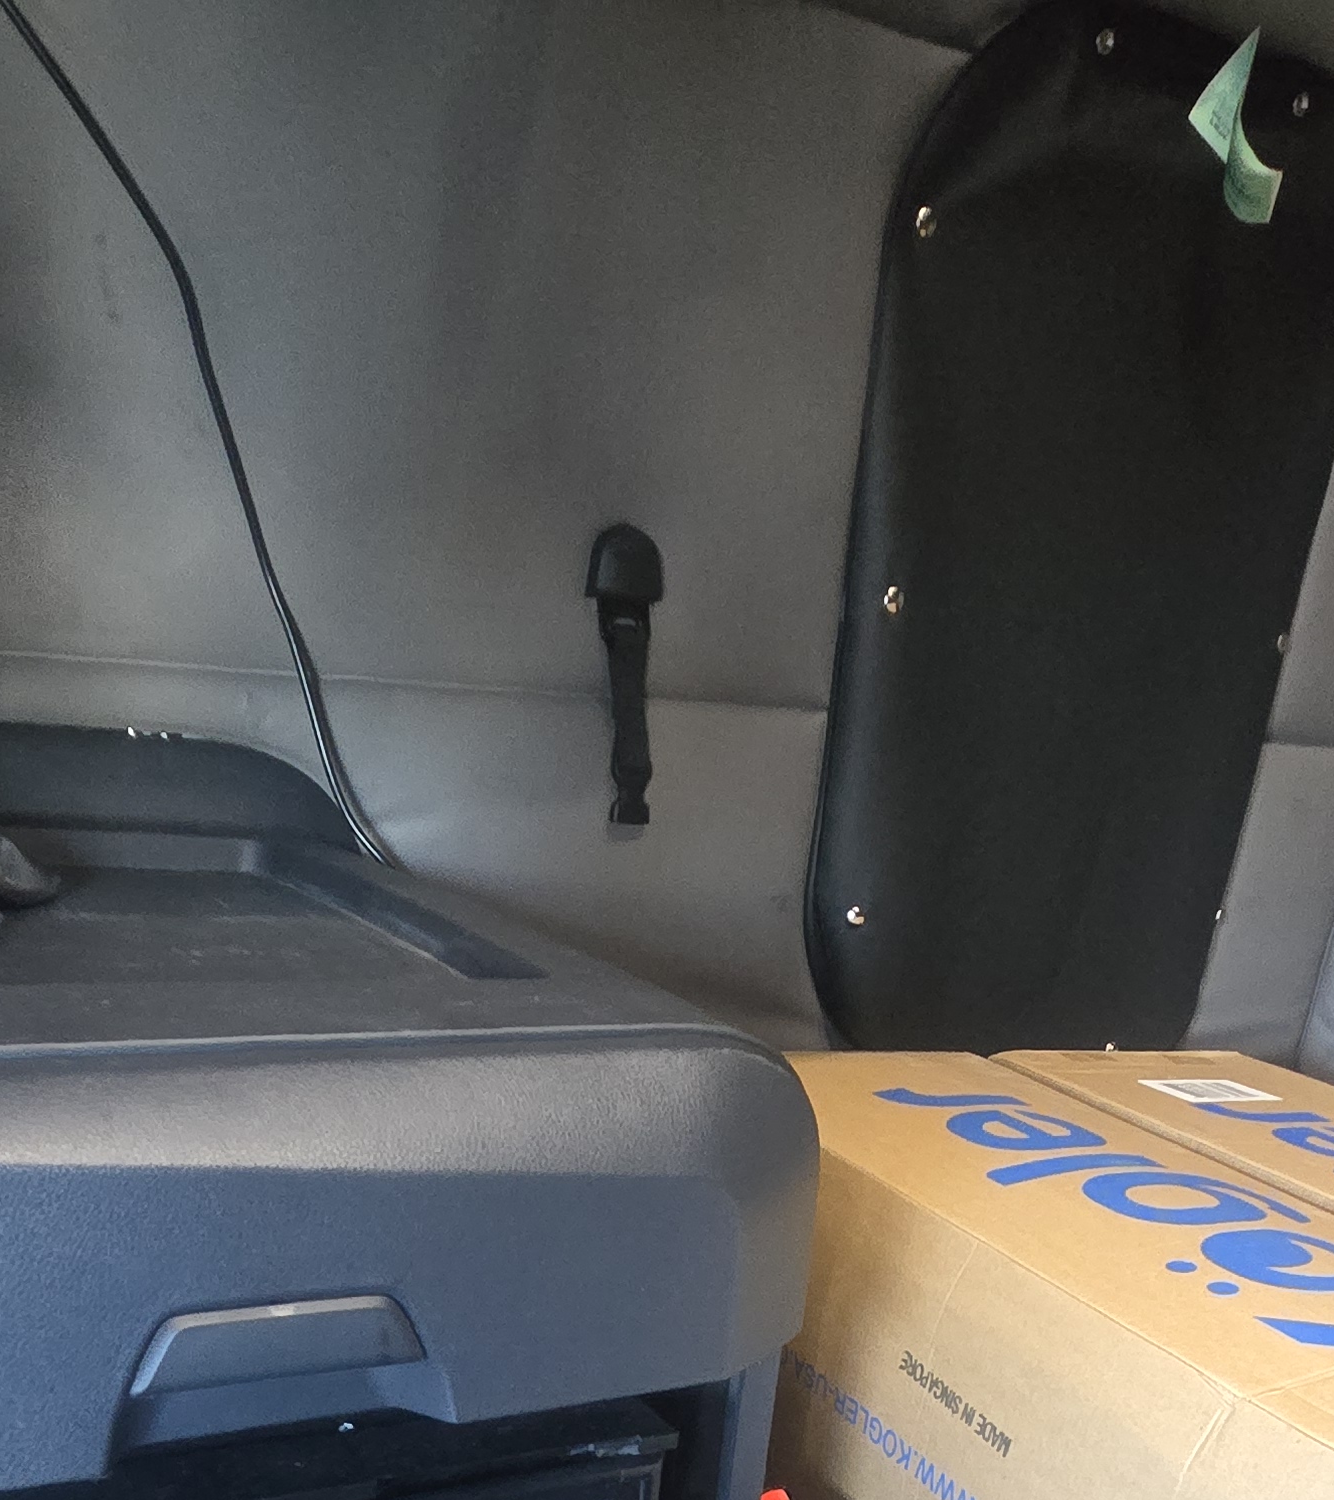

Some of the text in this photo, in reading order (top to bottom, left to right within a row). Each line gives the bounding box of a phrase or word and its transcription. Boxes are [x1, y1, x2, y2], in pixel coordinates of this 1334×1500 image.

[898, 1350, 1012, 1458] MADE IN SINGAPORE
